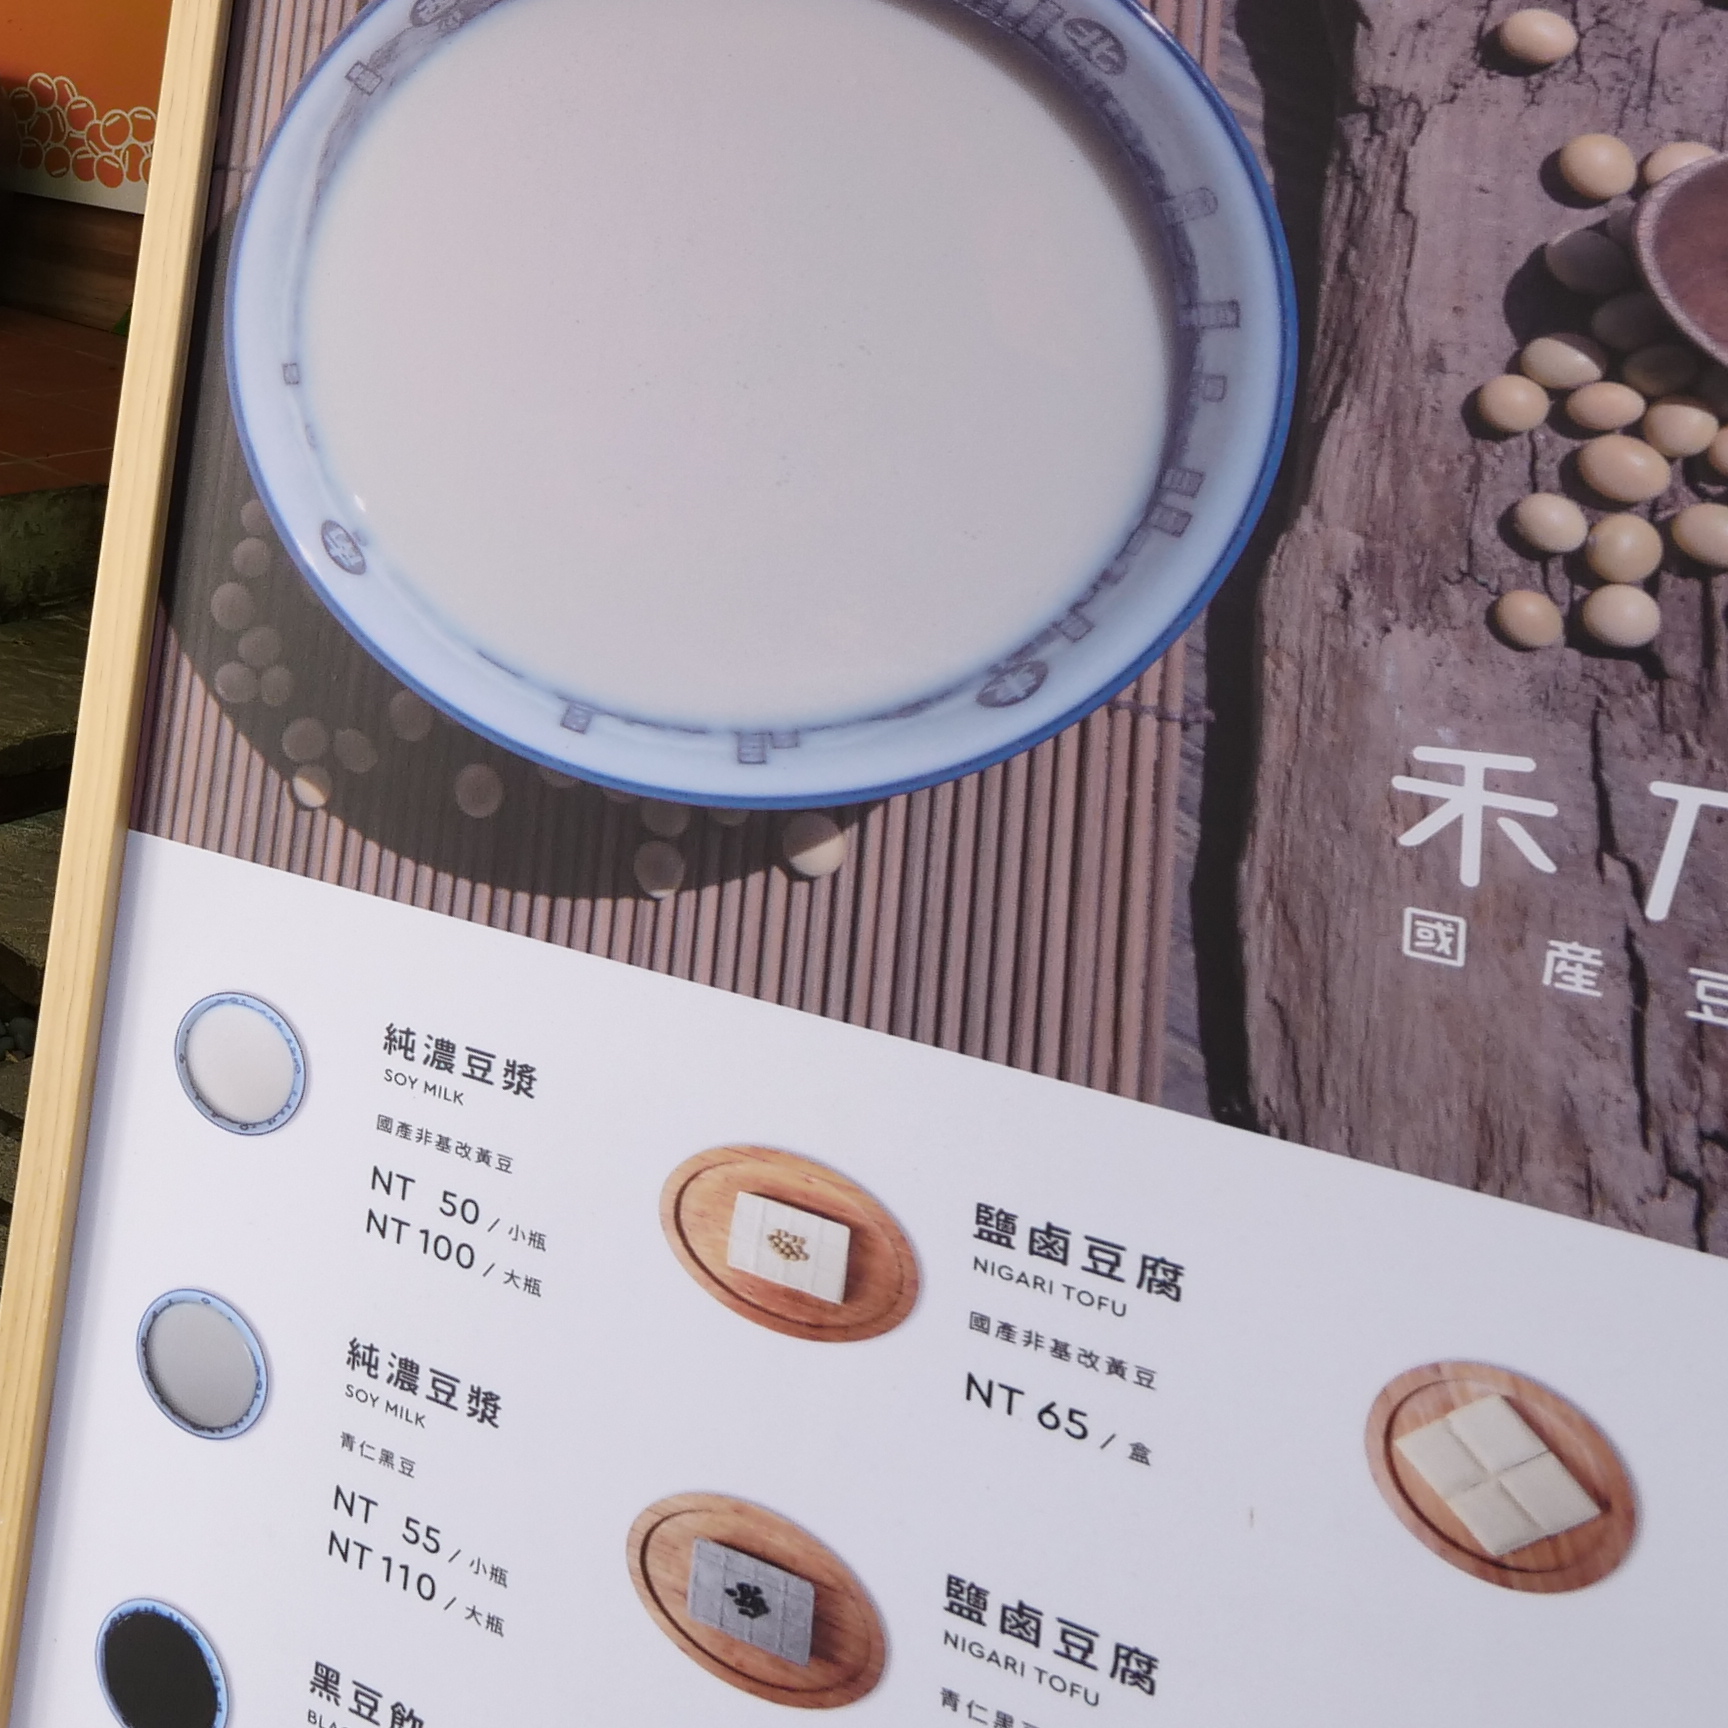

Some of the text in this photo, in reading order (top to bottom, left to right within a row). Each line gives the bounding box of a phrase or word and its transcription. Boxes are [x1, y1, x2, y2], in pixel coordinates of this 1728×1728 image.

[382, 1022, 540, 1100] 純濃豆漿
[383, 1067, 466, 1107] SOY MILK
[376, 1113, 515, 1176] 國產非基改黃豆
[369, 1165, 417, 1202] NT
[438, 1189, 482, 1226] 50
[508, 1223, 548, 1253] 小瓶
[365, 1209, 412, 1245] NT
[418, 1228, 476, 1271] 100
[503, 1268, 544, 1299] 大瓶
[972, 1201, 1186, 1303] 鹽鹵豆腐
[972, 1255, 1128, 1319] NIGARI TOFU
[345, 1335, 504, 1430] 純濃豆漿
[968, 1309, 1158, 1392] 國產非基改黃豆
[345, 1383, 427, 1429] SOY MILK
[964, 1371, 1025, 1418] NT
[1036, 1399, 1090, 1442] 65
[1127, 1439, 1154, 1468] 盒
[339, 1430, 417, 1480] 青仁黑豆
[332, 1484, 379, 1525] NT
[401, 1516, 442, 1556] 55
[468, 1555, 510, 1591] 小瓶
[327, 1530, 374, 1573] NT
[381, 1555, 438, 1603] 110
[464, 1602, 507, 1639] 大瓶
[942, 1573, 1160, 1698] 鹽鹵豆腐
[943, 1628, 1100, 1708] NIGARI TOFU
